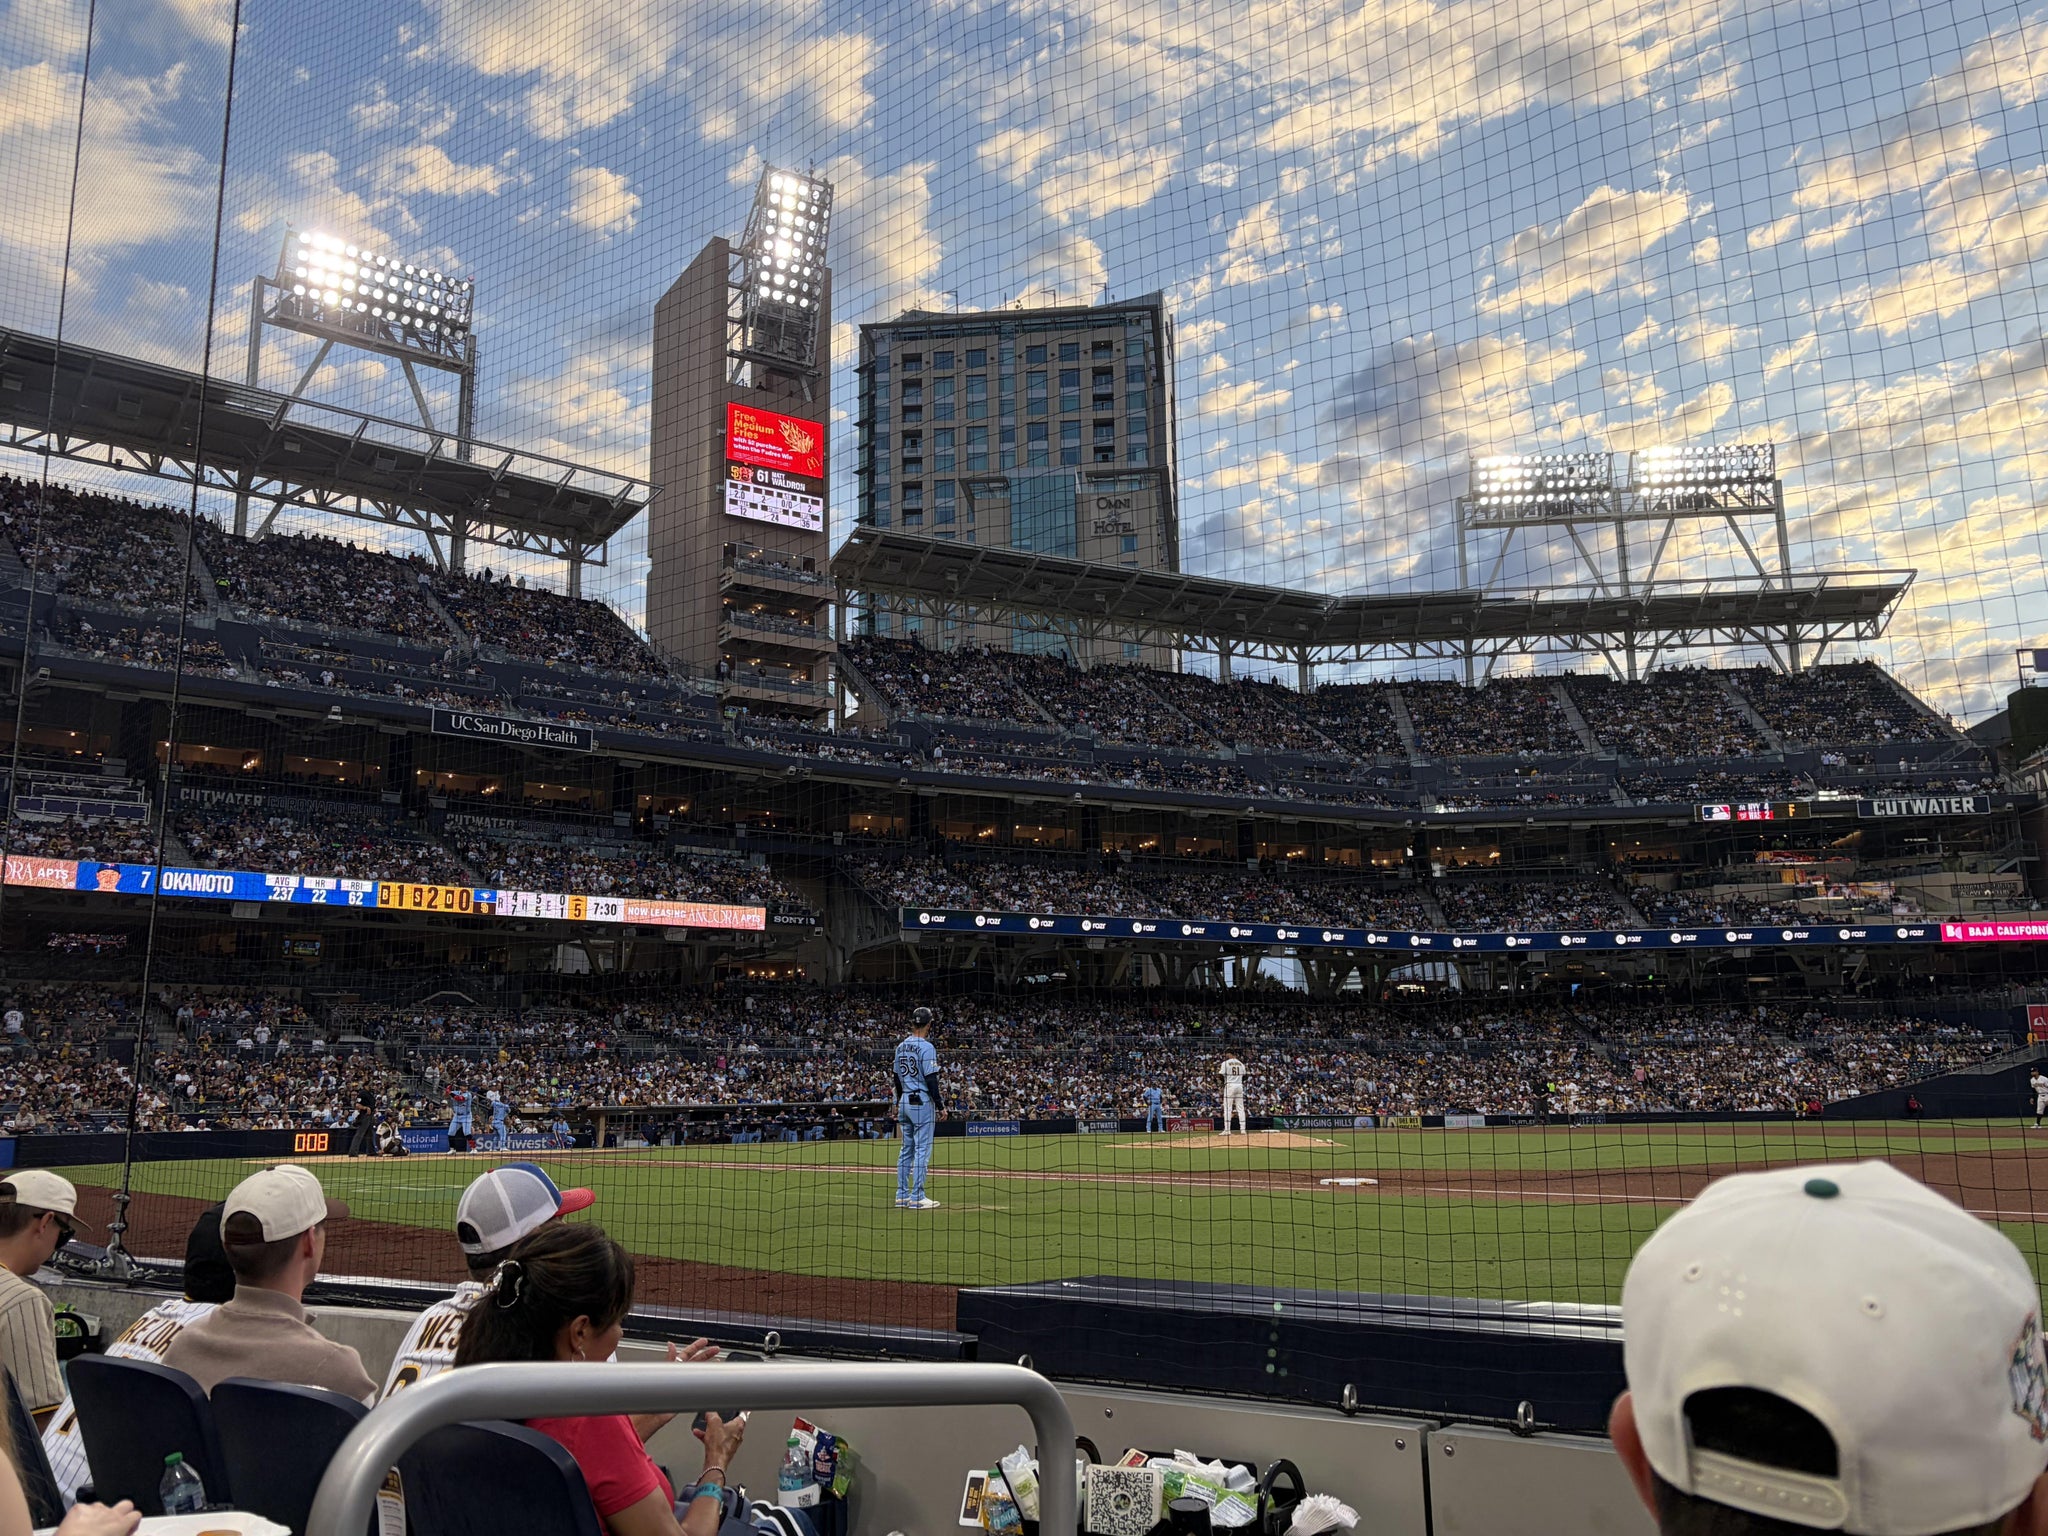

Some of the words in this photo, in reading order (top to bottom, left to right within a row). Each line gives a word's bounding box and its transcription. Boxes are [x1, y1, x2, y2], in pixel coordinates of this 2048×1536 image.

[734, 410, 756, 422] Free
[734, 419, 774, 434] Medium
[734, 427, 759, 439] Fries
[756, 441, 783, 451] purchase
[761, 448, 781, 457] Padres
[757, 470, 769, 483] 61
[772, 472, 785, 480] MATT
[772, 478, 806, 491] WALDRON
[734, 490, 746, 499] 2.0
[781, 500, 792, 509] 0/0
[1097, 497, 1130, 510] OMNI
[740, 507, 747, 516] 12
[771, 514, 779, 522] 24
[801, 520, 810, 528] 36
[451, 714, 472, 731] UC
[474, 718, 498, 734] San
[501, 721, 536, 741] Diego
[538, 726, 577, 744] Health
[180, 788, 263, 807] CUTWATER
[1788, 804, 1795, 817] F
[1873, 797, 1975, 816] CUTWATER
[38, 867, 68, 880] APTS
[141, 871, 151, 888] 7
[162, 871, 234, 894] OKAMOTO
[275, 877, 290, 886] AVG
[315, 879, 325, 888] HR
[350, 882, 363, 890] RBI
[268, 887, 295, 900] .237
[312, 890, 326, 903] 22
[348, 892, 363, 905] 62
[382, 889, 389, 900] B
[398, 885, 404, 907] 1
[415, 891, 421, 903] S
[427, 887, 438, 909] 2
[458, 889, 470, 911] 0
[498, 897, 503, 908] R
[512, 892, 518, 902] 4
[522, 899, 528, 910] H
[536, 893, 541, 904] 5
[547, 900, 551, 911] E
[560, 895, 565, 906] 0
[574, 903, 581, 918] 5
[593, 903, 617, 915] 7:30
[511, 905, 517, 915] 7
[535, 906, 540, 917] 5
[628, 906, 649, 916] NOW
[650, 908, 687, 919] LEASING
[688, 908, 739, 925] ANCORA
[740, 914, 761, 923] APTS
[773, 915, 804, 925] SONY
[931, 915, 946, 923] razr
[1092, 922, 1106, 930] razr
[1142, 924, 1156, 932] razr
[1968, 927, 1994, 936] BAJA
[899, 1056, 919, 1077] 53
[1232, 1067, 1240, 1076] 61
[1301, 1119, 1332, 1127] SINGING
[1334, 1118, 1352, 1127] HILLS
[968, 1125, 1010, 1134] citycruises
[295, 1133, 329, 1152] 008
